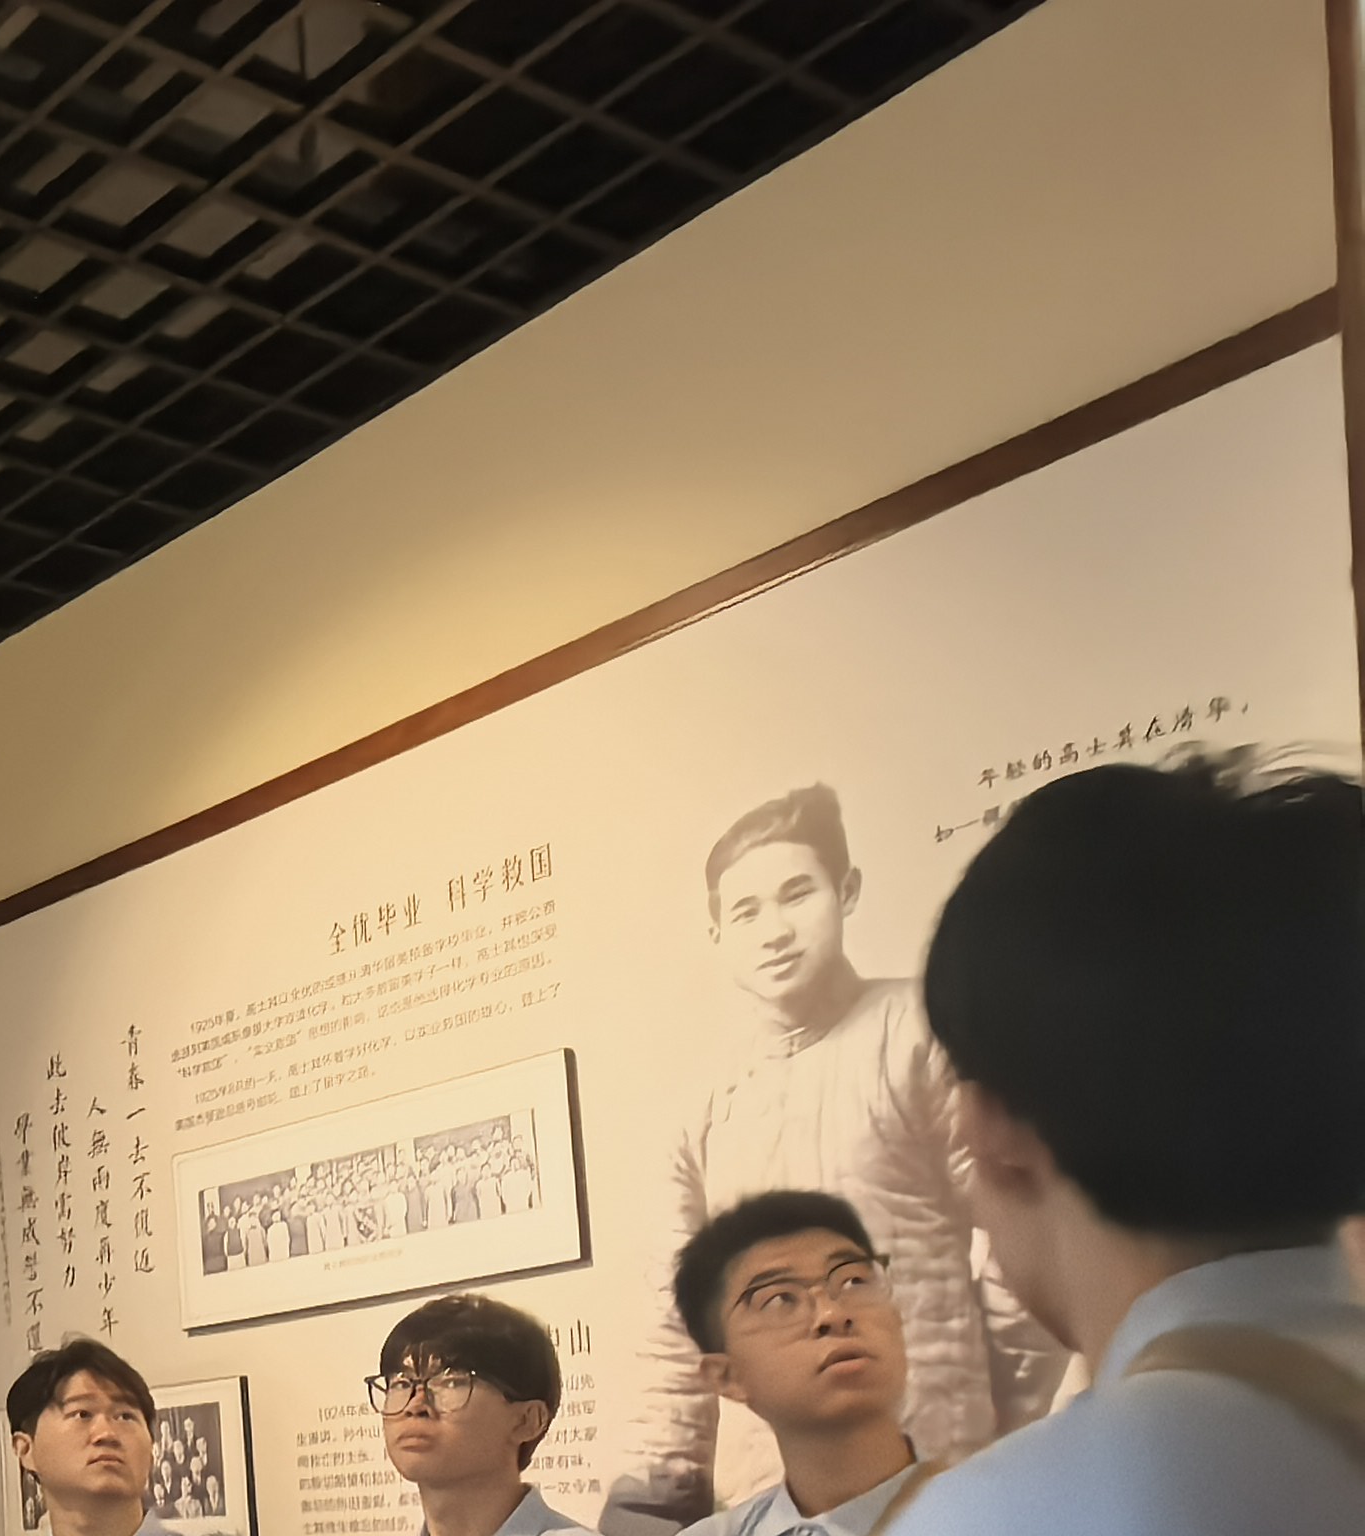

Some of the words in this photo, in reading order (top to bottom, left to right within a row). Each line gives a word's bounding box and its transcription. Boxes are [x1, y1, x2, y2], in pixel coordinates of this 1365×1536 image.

[328, 892, 422, 956] 全优毕业
[447, 842, 553, 913] 科学救国
